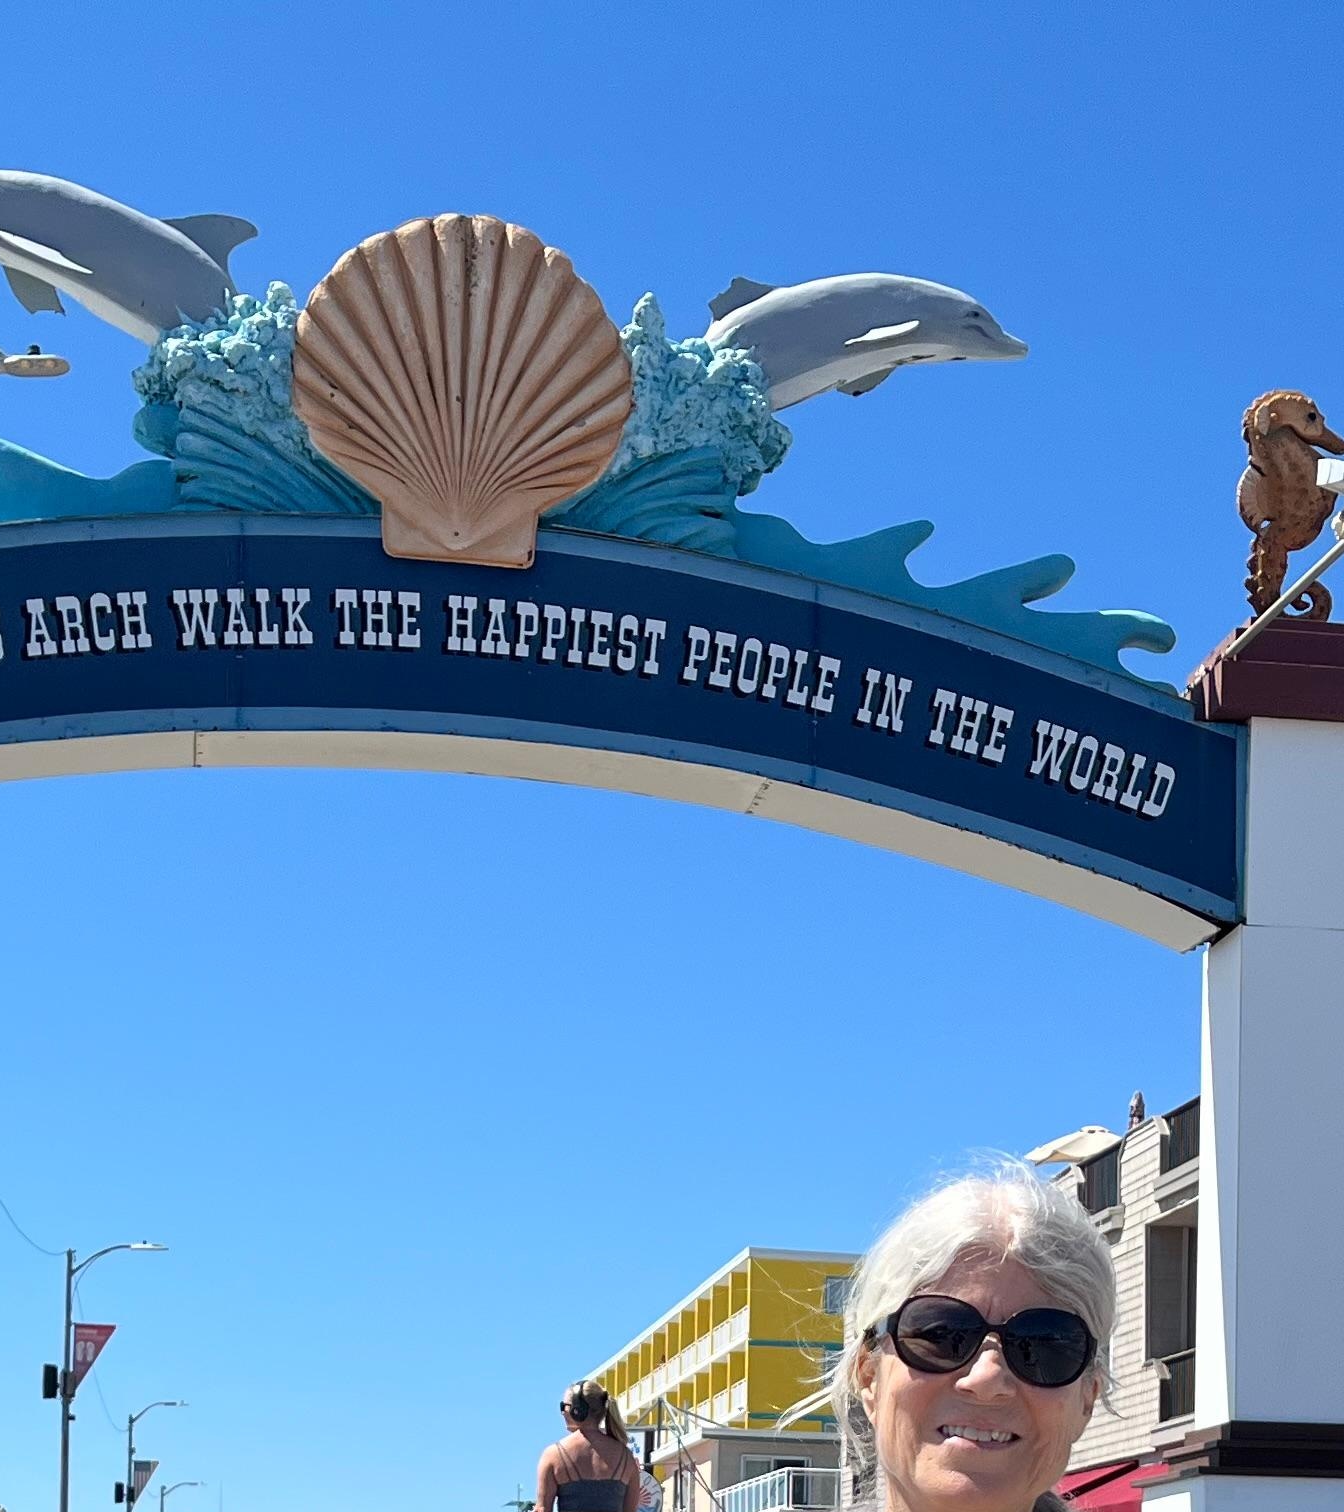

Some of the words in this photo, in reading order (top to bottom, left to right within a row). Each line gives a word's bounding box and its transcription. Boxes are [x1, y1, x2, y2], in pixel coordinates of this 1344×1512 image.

[26, 591, 152, 657] ARCH
[173, 588, 313, 646] WALK
[335, 588, 421, 648] THE
[447, 595, 667, 675] HAPPIEST
[683, 625, 841, 713] PEOPLE
[856, 668, 913, 732] IN
[929, 688, 1015, 763] THE
[1029, 719, 1176, 817] WORLD
